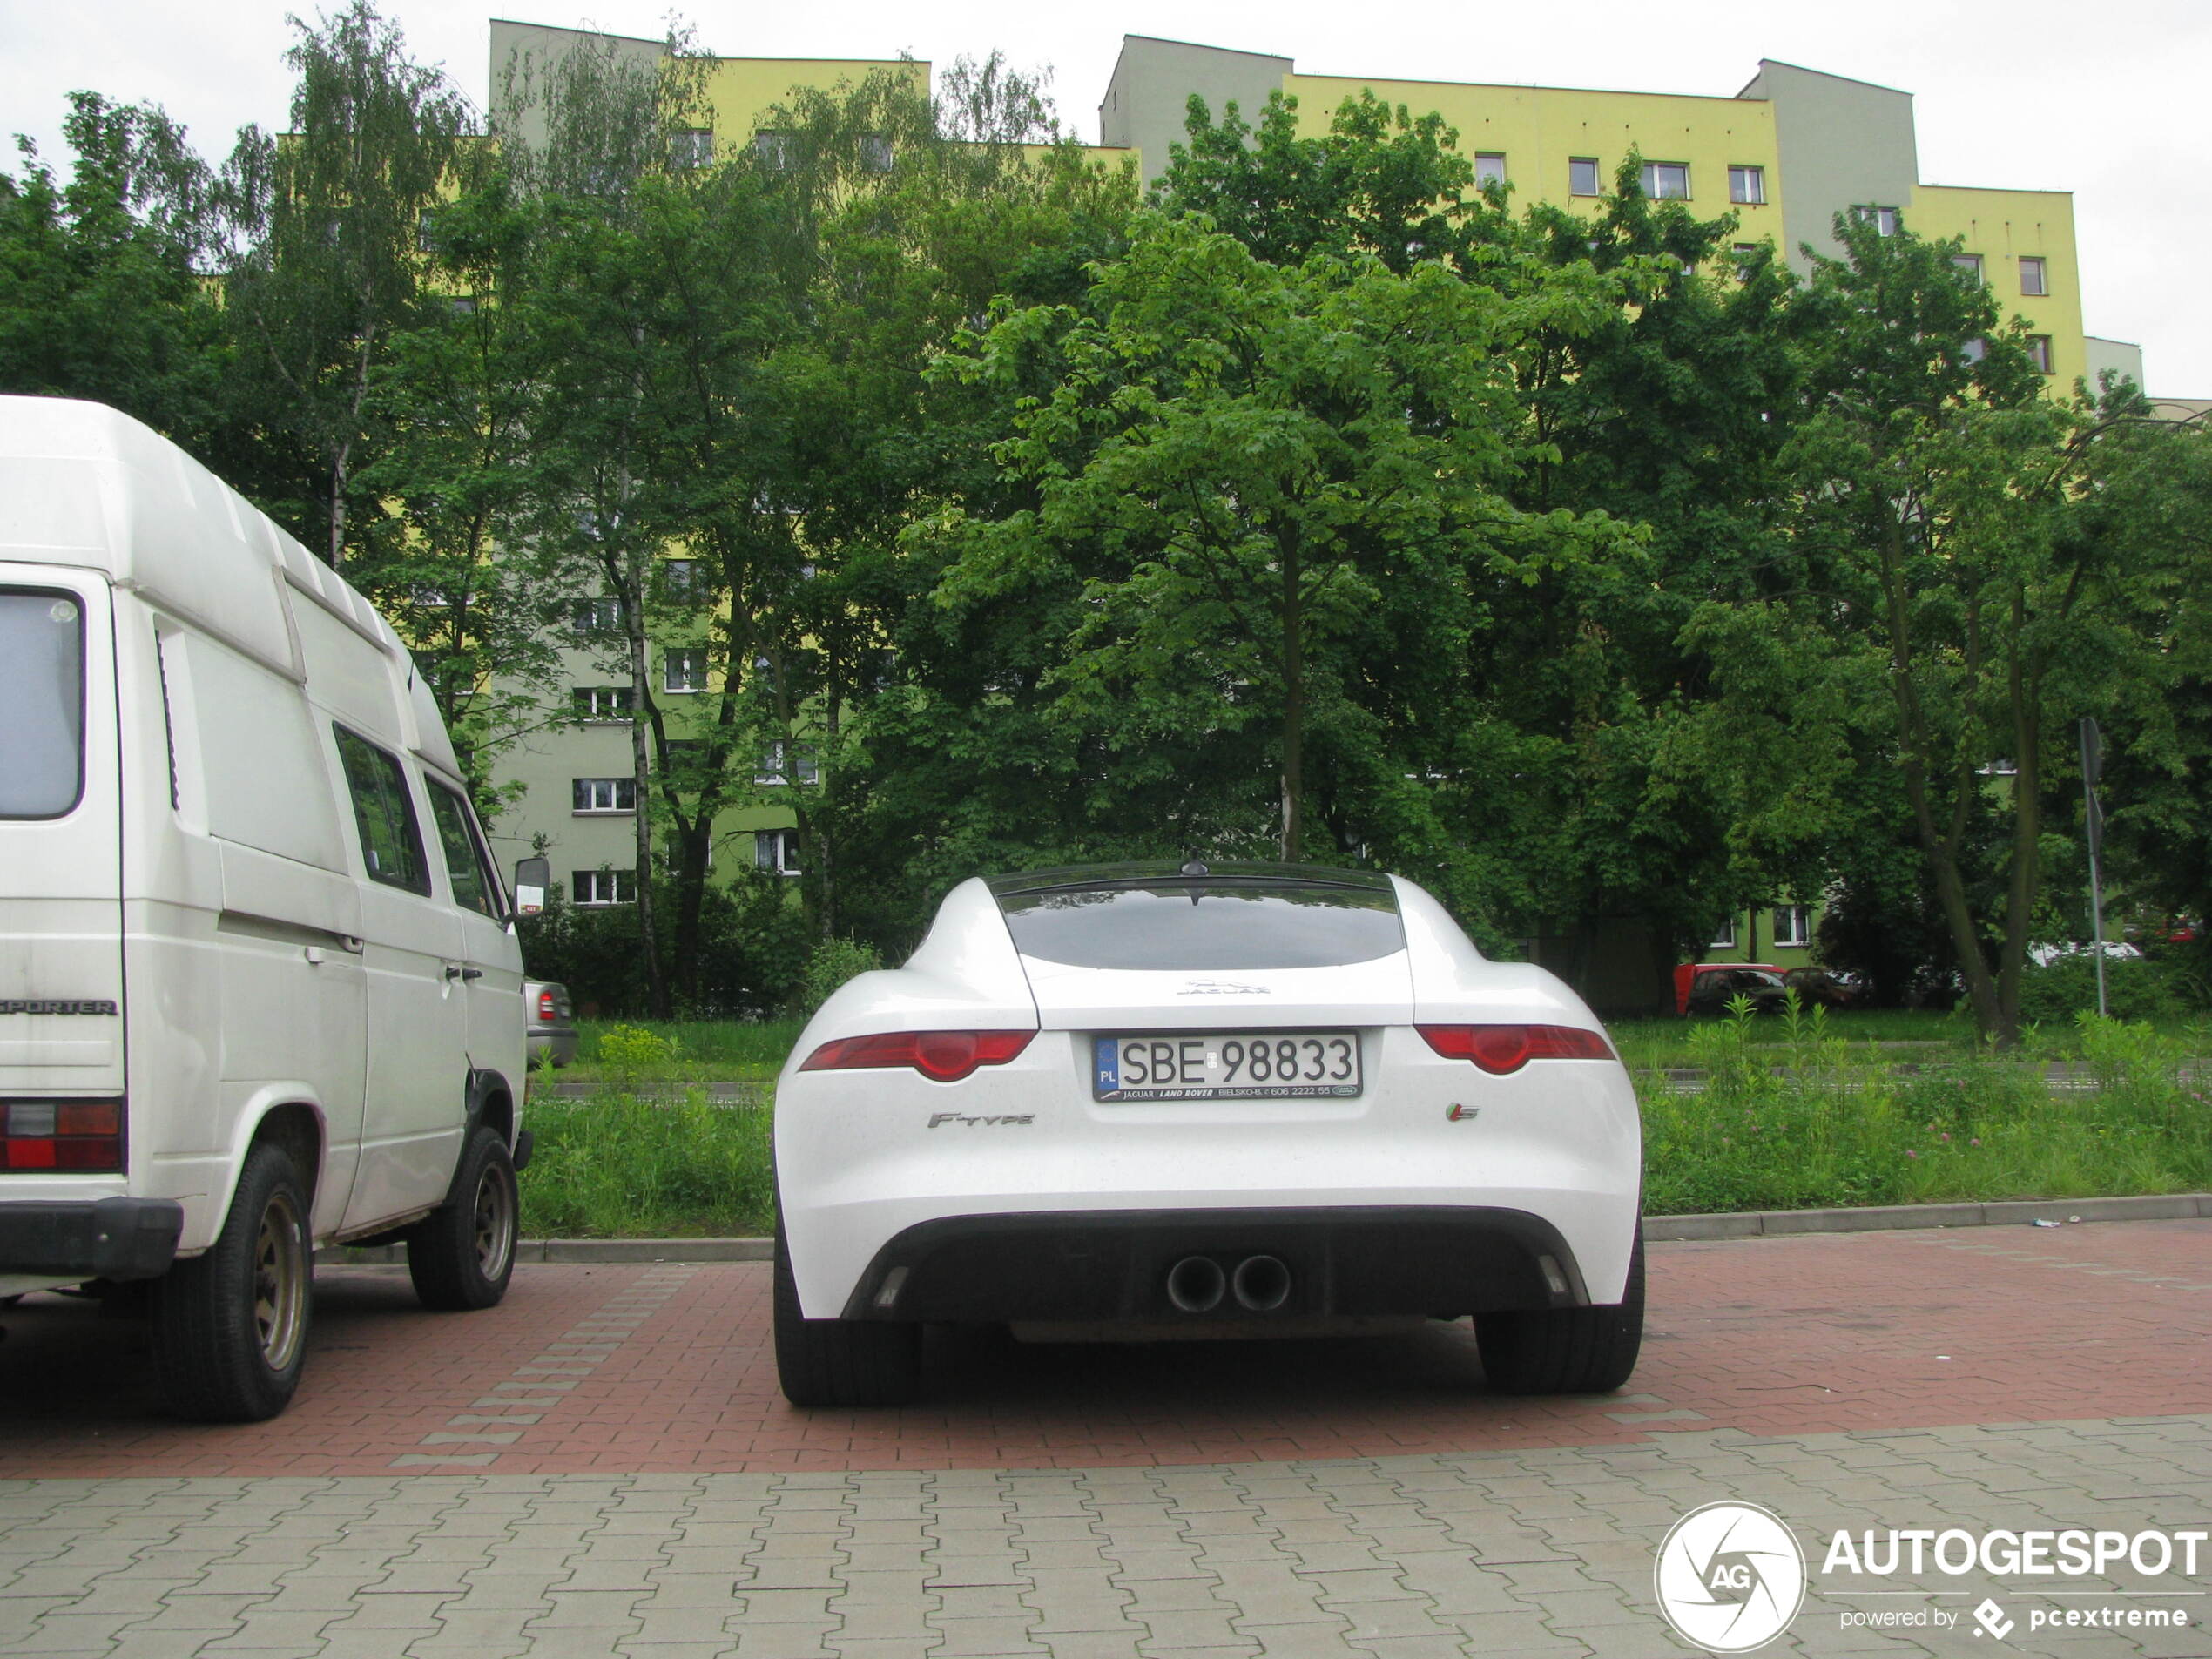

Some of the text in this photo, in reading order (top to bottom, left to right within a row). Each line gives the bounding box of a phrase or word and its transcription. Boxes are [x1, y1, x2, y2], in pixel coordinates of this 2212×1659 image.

[1123, 1038, 1352, 1084] SBE 98833
[1100, 1070, 1116, 1082] PL
[1123, 1090, 1155, 1100] JAGUAR
[1184, 1089, 1214, 1097] ROVER
[1271, 1087, 1289, 1096] 606
[1291, 1087, 1315, 1096] 2222
